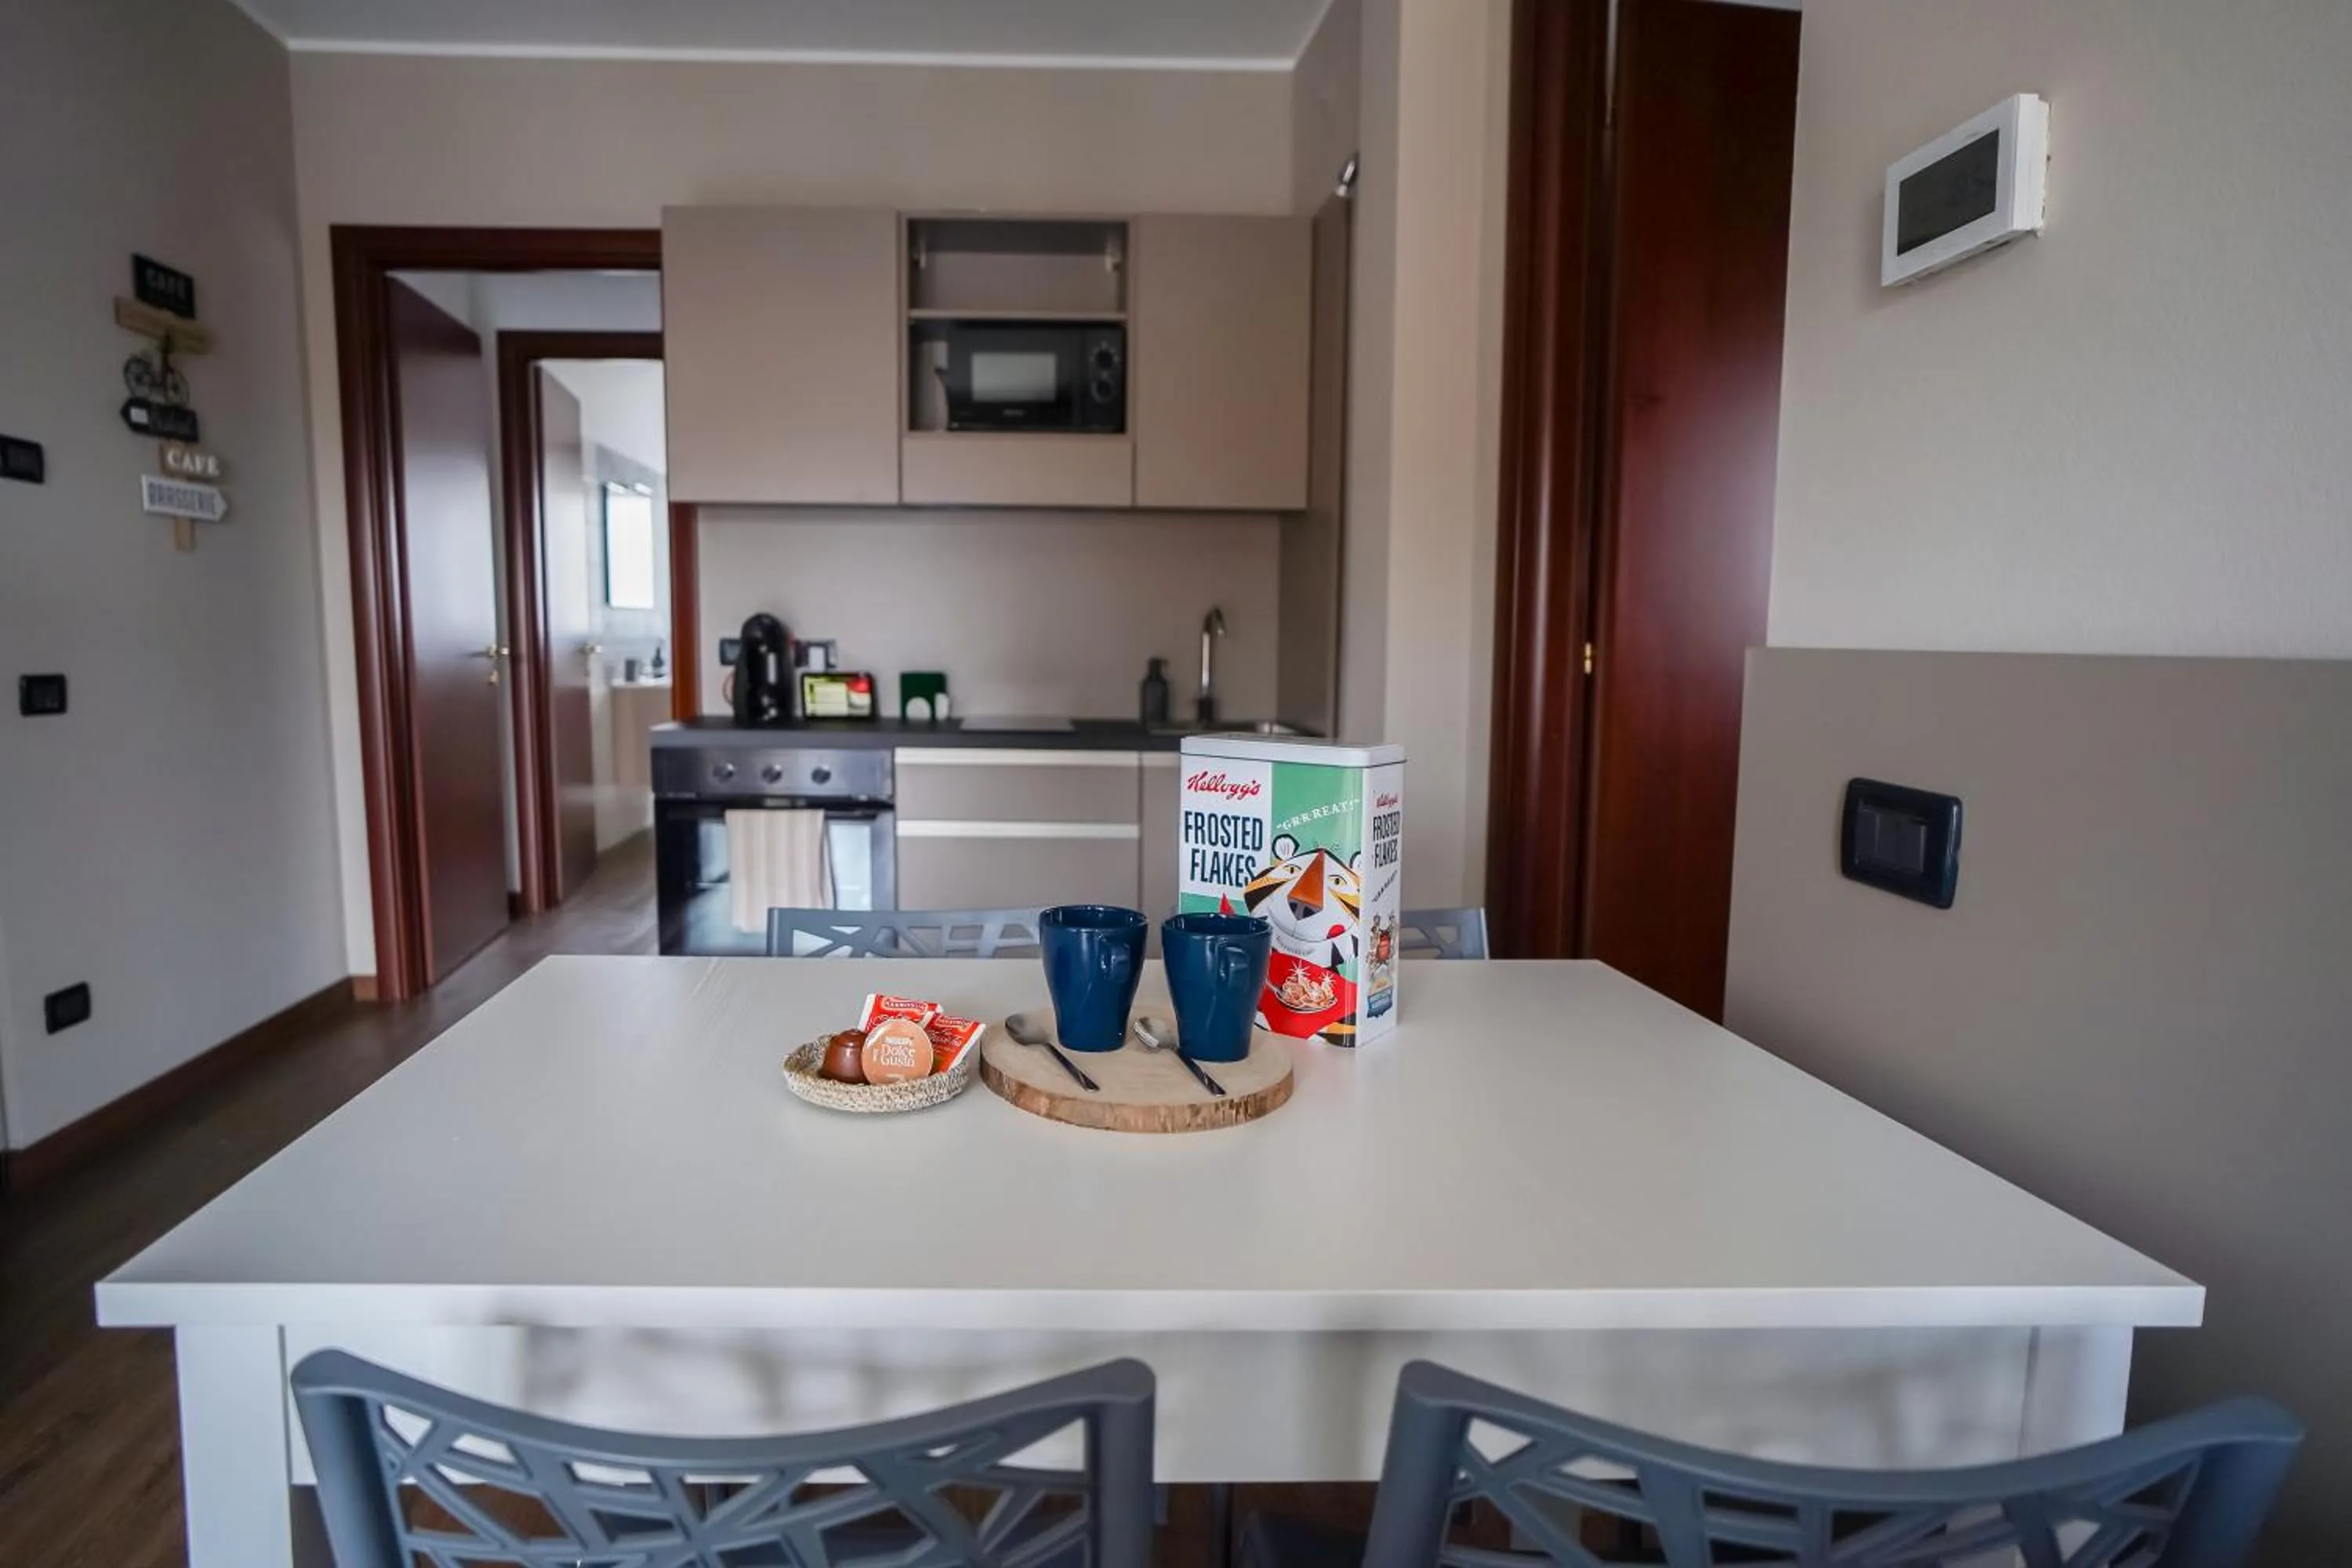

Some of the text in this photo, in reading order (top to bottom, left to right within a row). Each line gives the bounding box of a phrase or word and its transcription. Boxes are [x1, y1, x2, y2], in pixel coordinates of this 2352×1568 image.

[1187, 771, 1262, 800] Kellogg's
[1184, 810, 1264, 852] FROSTED
[1189, 848, 1257, 887] FLAKES
